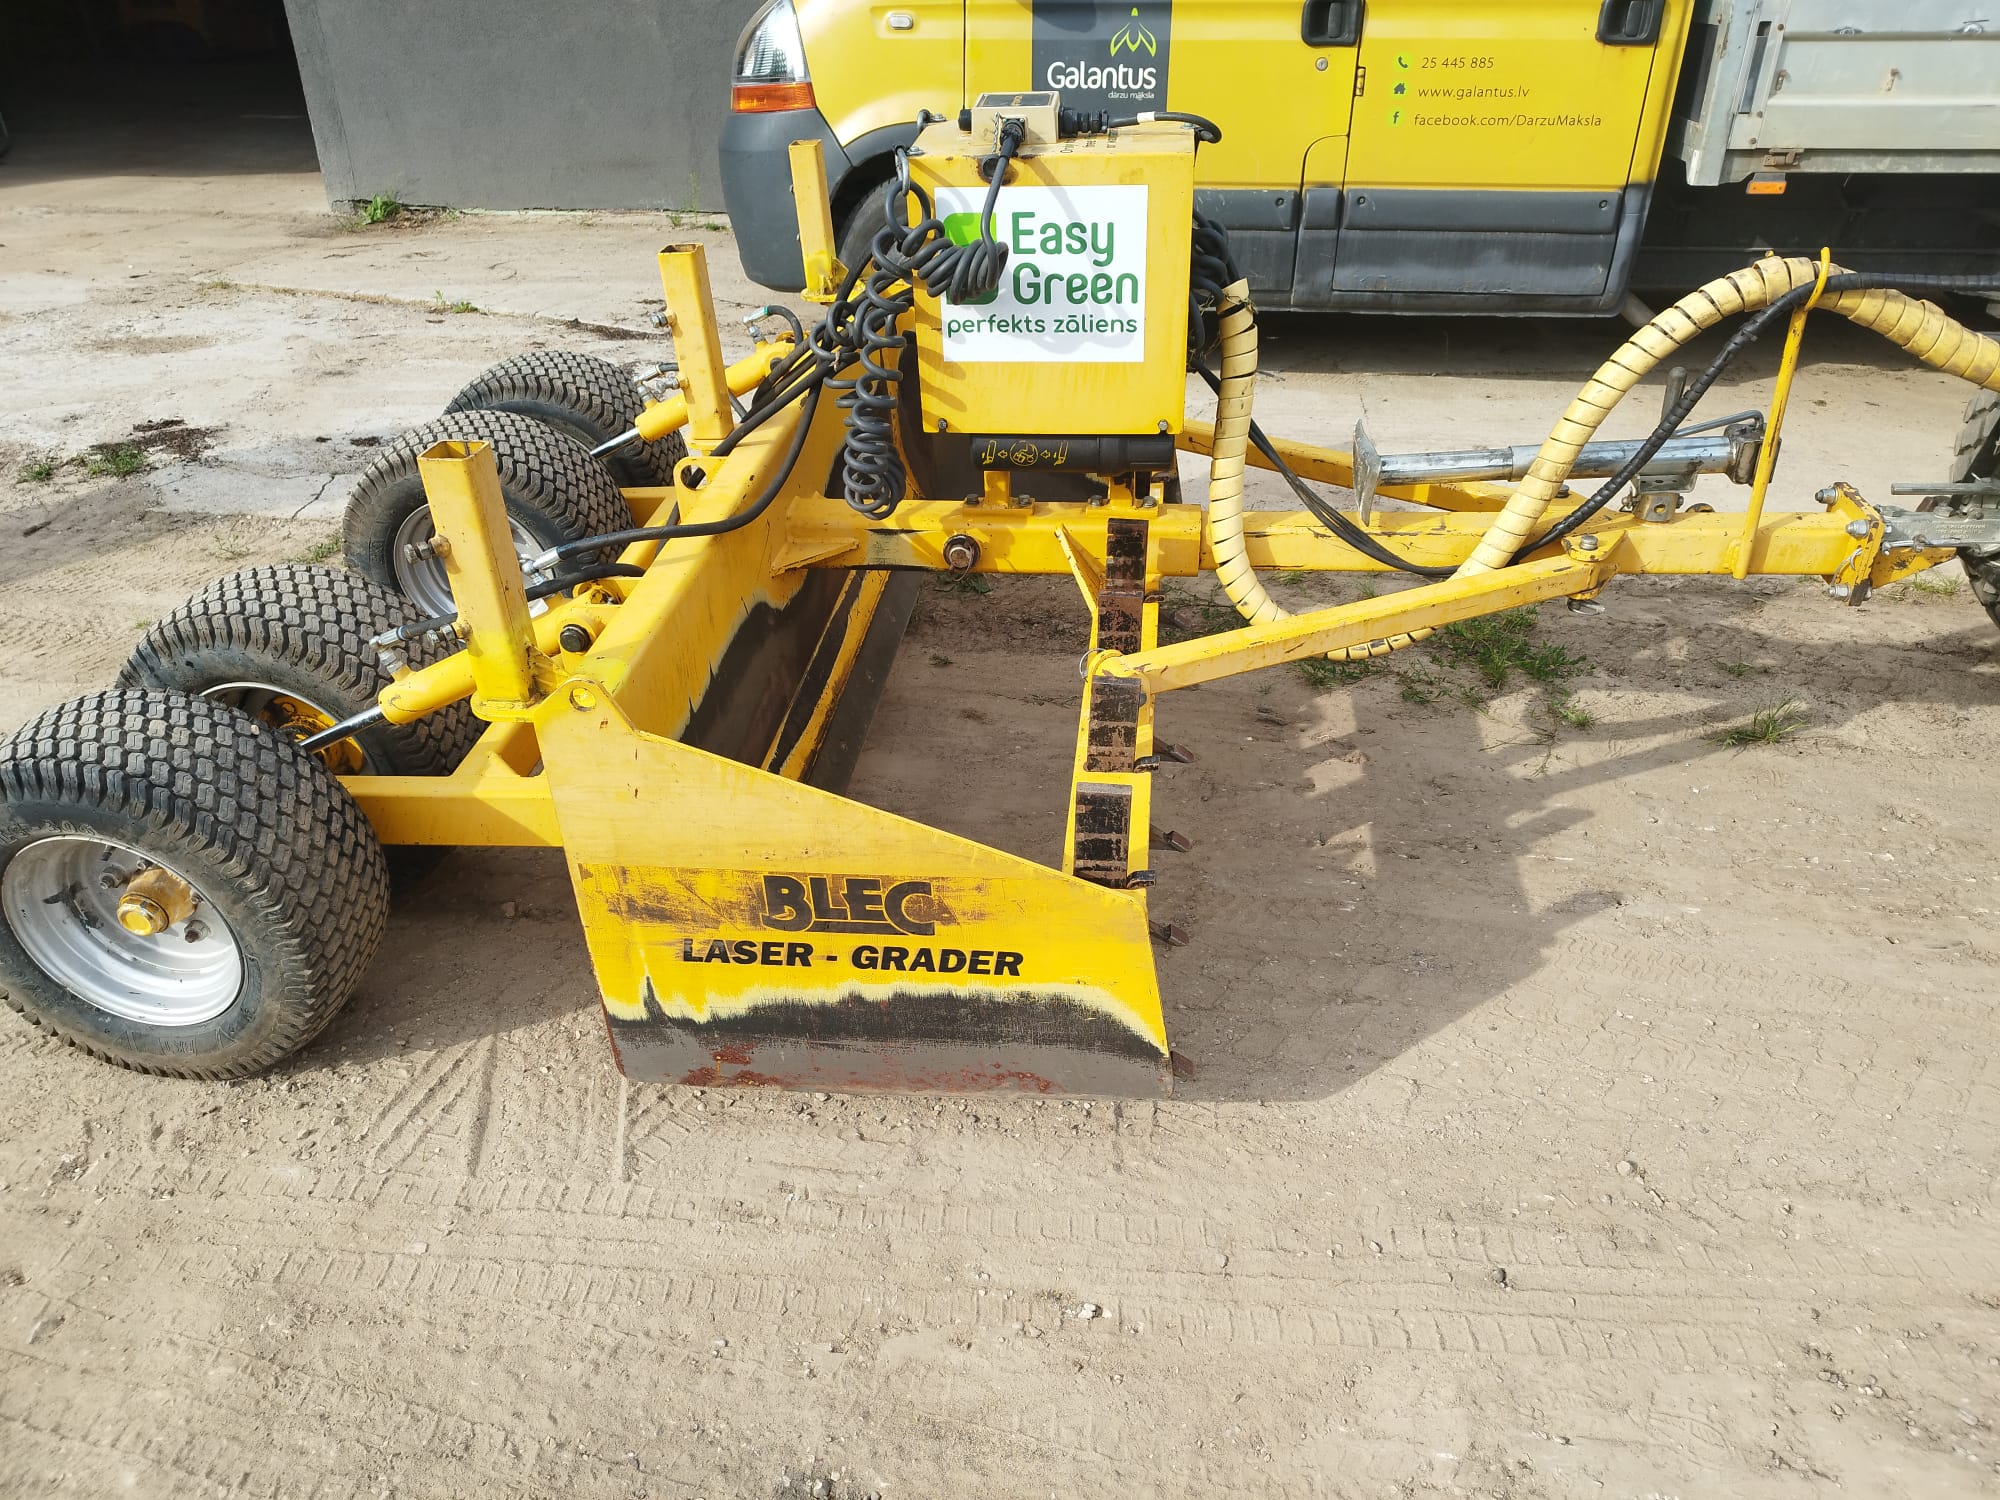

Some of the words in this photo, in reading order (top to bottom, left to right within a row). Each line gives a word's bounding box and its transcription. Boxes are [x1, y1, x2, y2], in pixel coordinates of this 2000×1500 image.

[1047, 61, 1156, 90] Galantus
[1422, 57, 1437, 69] 25
[1441, 57, 1465, 69] 445
[1470, 57, 1494, 69] 885
[1418, 85, 1530, 100] www.galantus.lv
[1414, 114, 1602, 127] facebook.com/DarzuMaksla
[1011, 211, 1114, 267] Easy
[1012, 262, 1138, 305] Green
[947, 314, 1046, 338] perfekts
[1054, 314, 1138, 333] zāliens
[762, 875, 935, 936] BLEC
[683, 938, 813, 967] LASER
[851, 945, 1024, 977] GRADER
